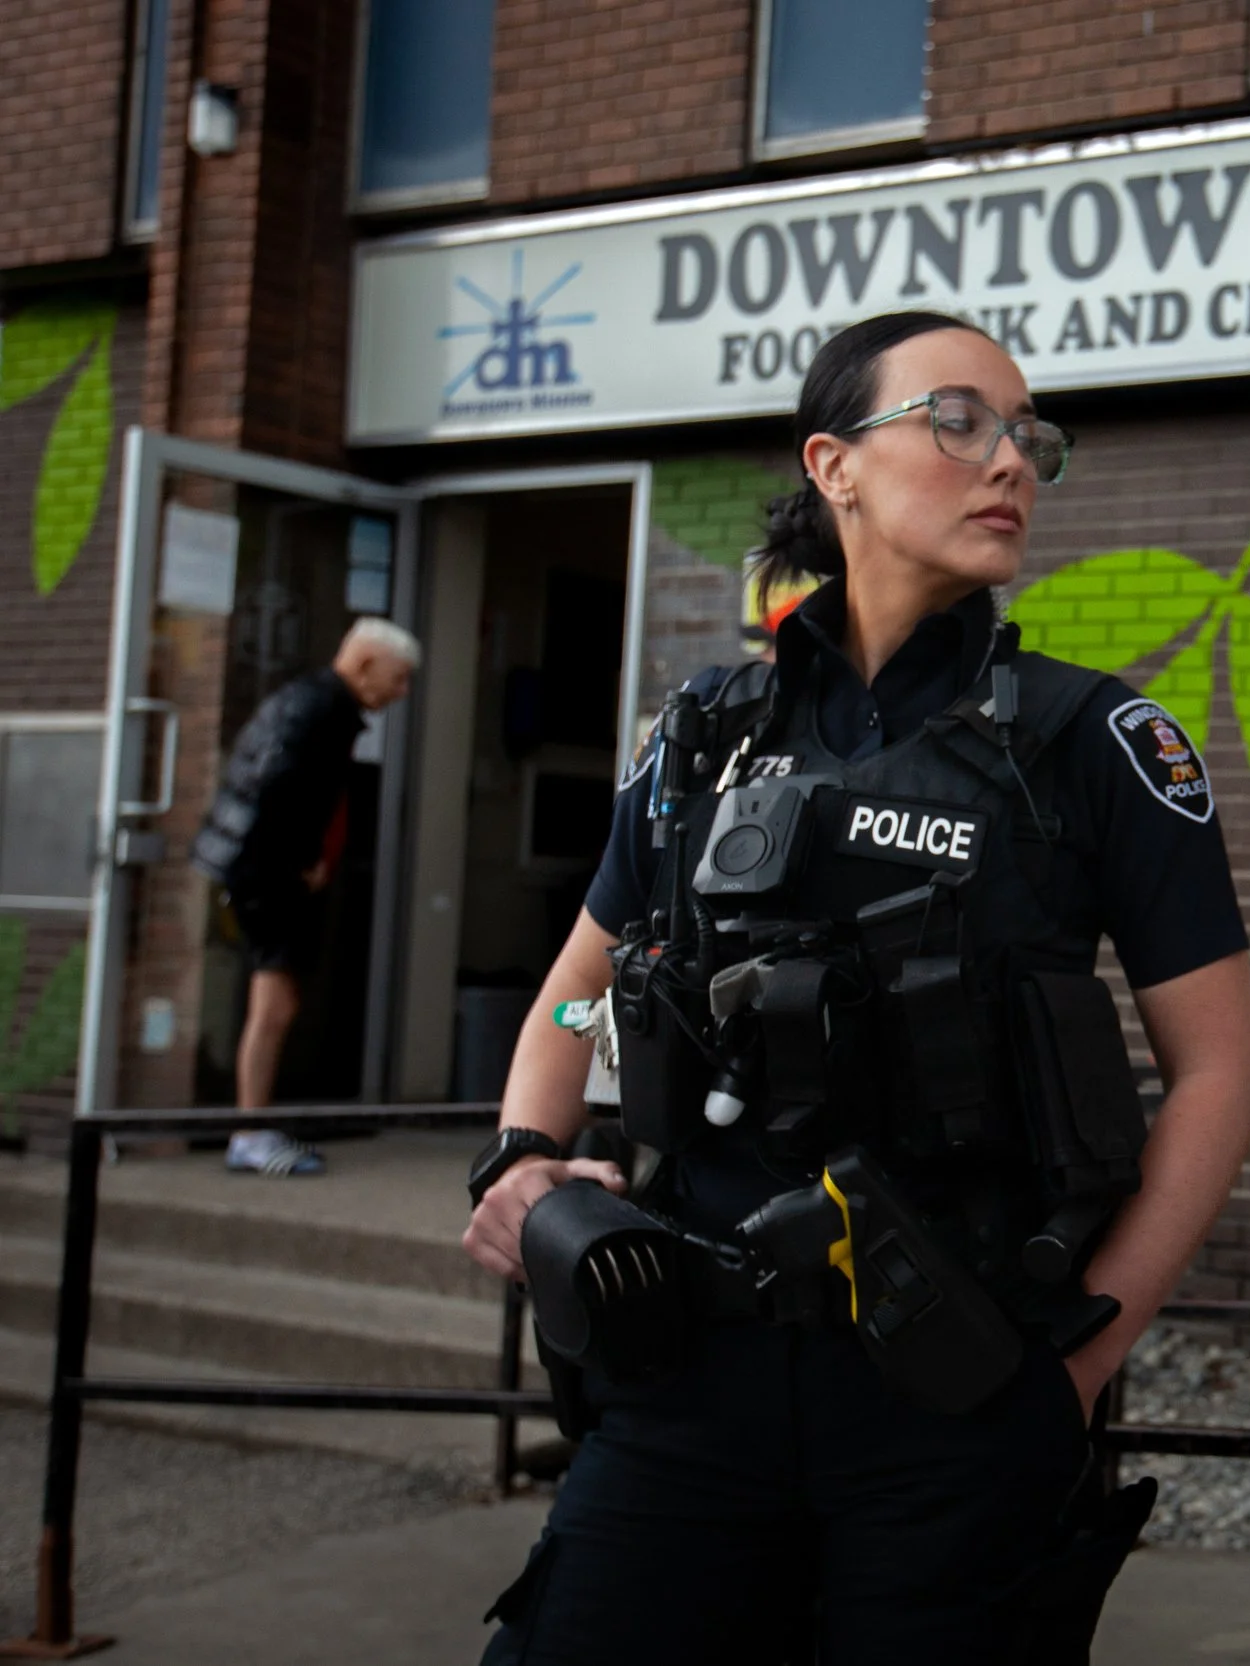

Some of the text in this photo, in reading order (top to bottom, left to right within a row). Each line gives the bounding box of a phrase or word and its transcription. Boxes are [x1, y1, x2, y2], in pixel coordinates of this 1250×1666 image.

[1053, 289, 1190, 356] AND
[747, 755, 795, 778] 775
[848, 805, 975, 861] POLICE
[721, 882, 744, 891] AXON
